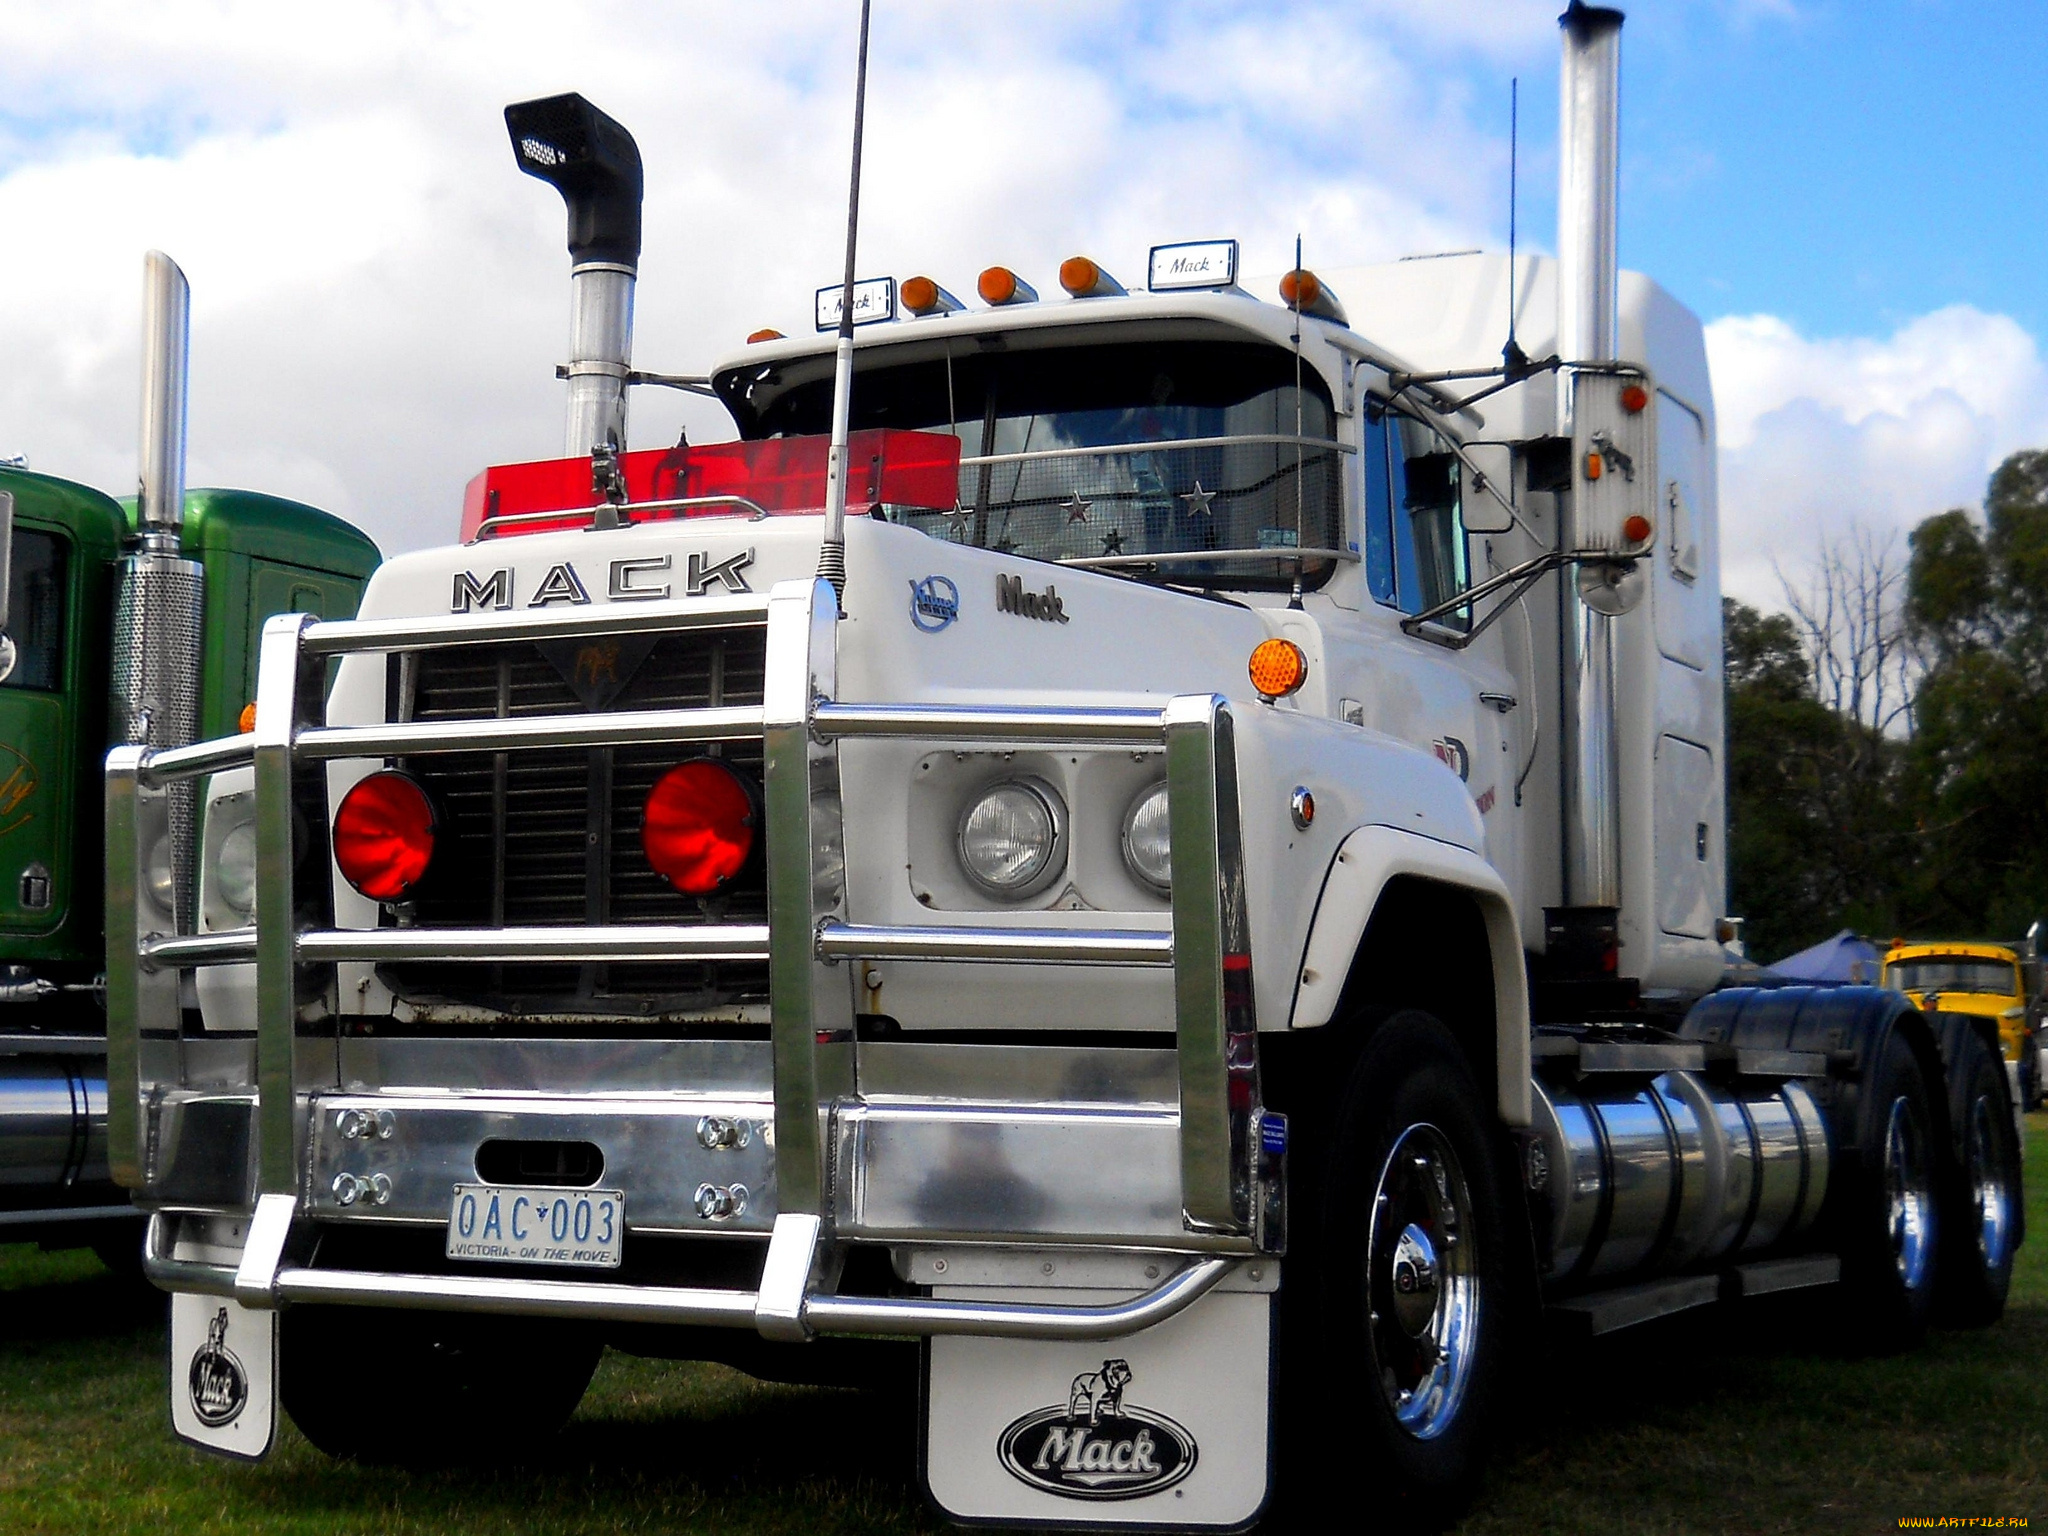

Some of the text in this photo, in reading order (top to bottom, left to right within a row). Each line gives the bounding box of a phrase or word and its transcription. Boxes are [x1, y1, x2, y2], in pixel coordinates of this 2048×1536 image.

[1169, 257, 1210, 274] Mack
[834, 294, 870, 313] Mck
[450, 546, 755, 614] MACK
[996, 573, 1070, 625] Mack
[551, 1198, 614, 1244] 003
[520, 1247, 539, 1257] ON
[543, 1248, 569, 1260] THE
[572, 1250, 611, 1262] MOVE
[195, 1361, 232, 1404] Mack
[1032, 1426, 1162, 1473] Mack
